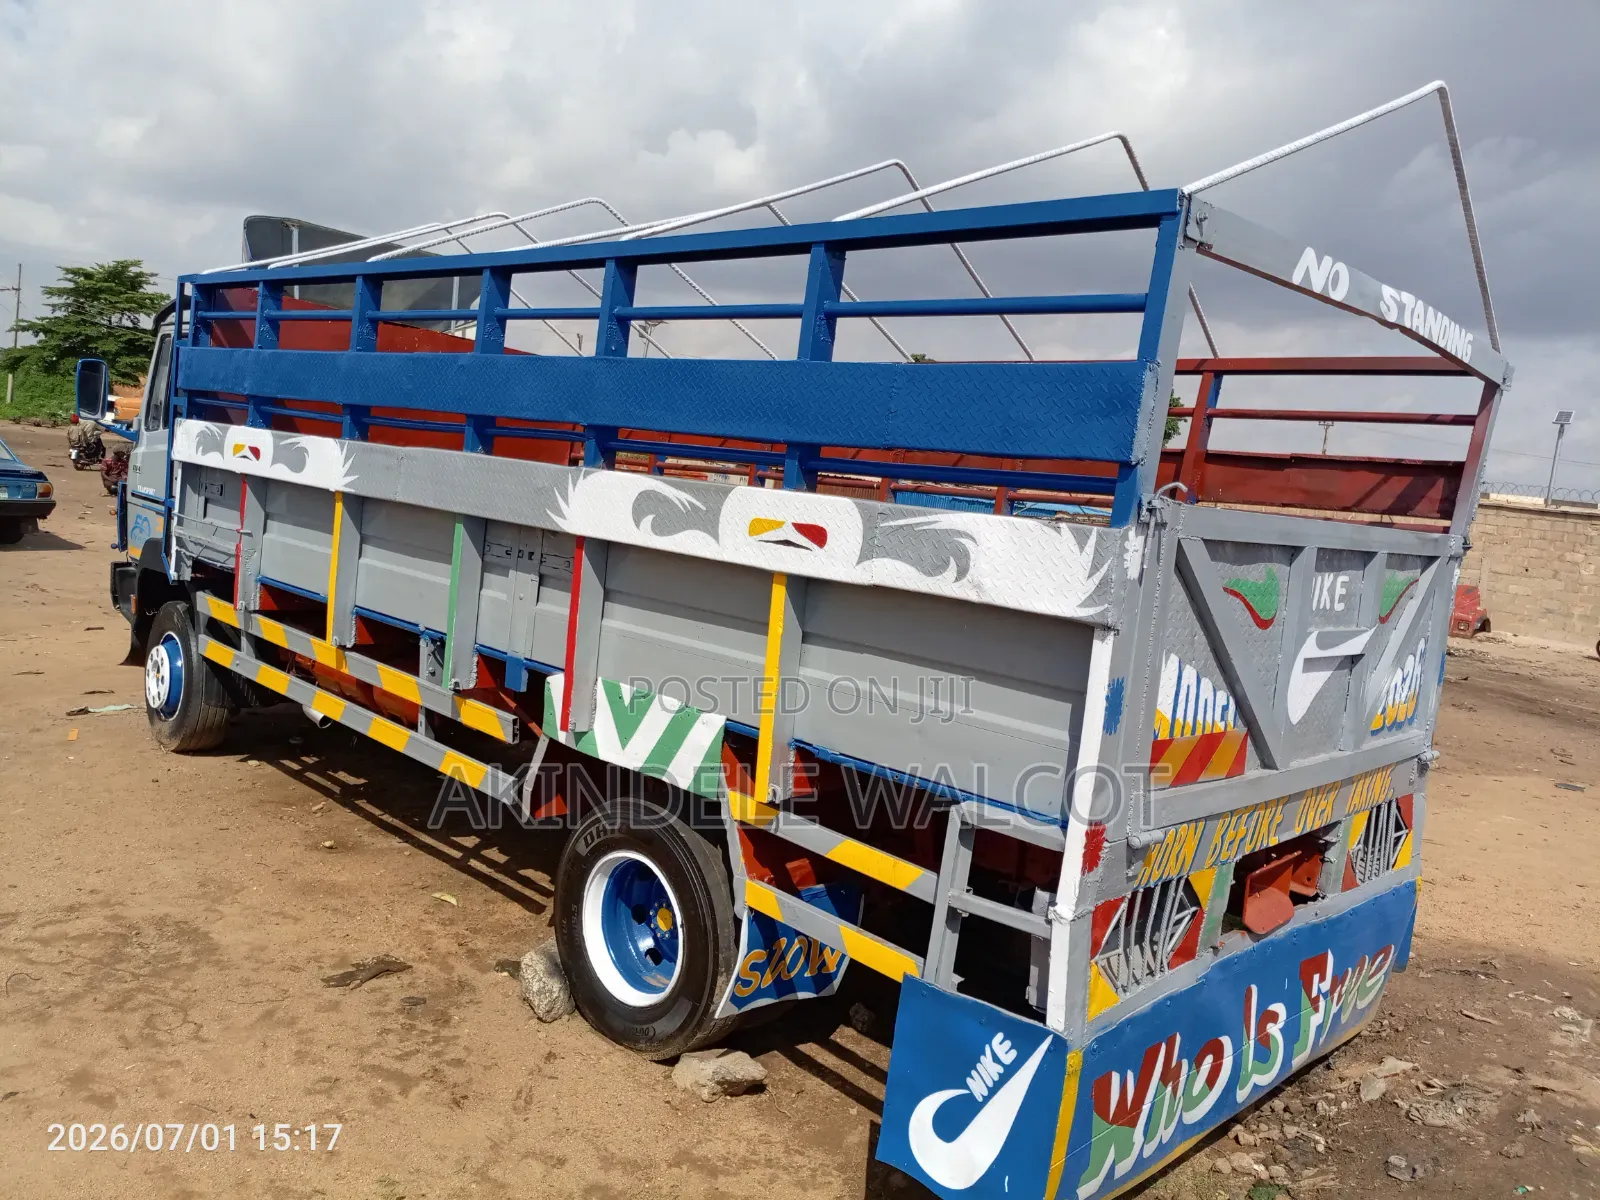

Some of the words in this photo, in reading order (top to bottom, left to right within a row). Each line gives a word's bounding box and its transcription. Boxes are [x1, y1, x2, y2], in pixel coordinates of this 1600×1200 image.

[1292, 246, 1350, 302] NO
[1379, 283, 1474, 363] STANDING
[1311, 572, 1349, 611] IKE
[1134, 818, 1206, 890] HORN
[1204, 796, 1289, 869] BEFORE
[1294, 780, 1342, 835] OVER
[966, 1032, 1018, 1102] NIKE
[1077, 1032, 1234, 1200] Who
[1237, 984, 1287, 1104] Is
[1291, 944, 1395, 1072] Free
